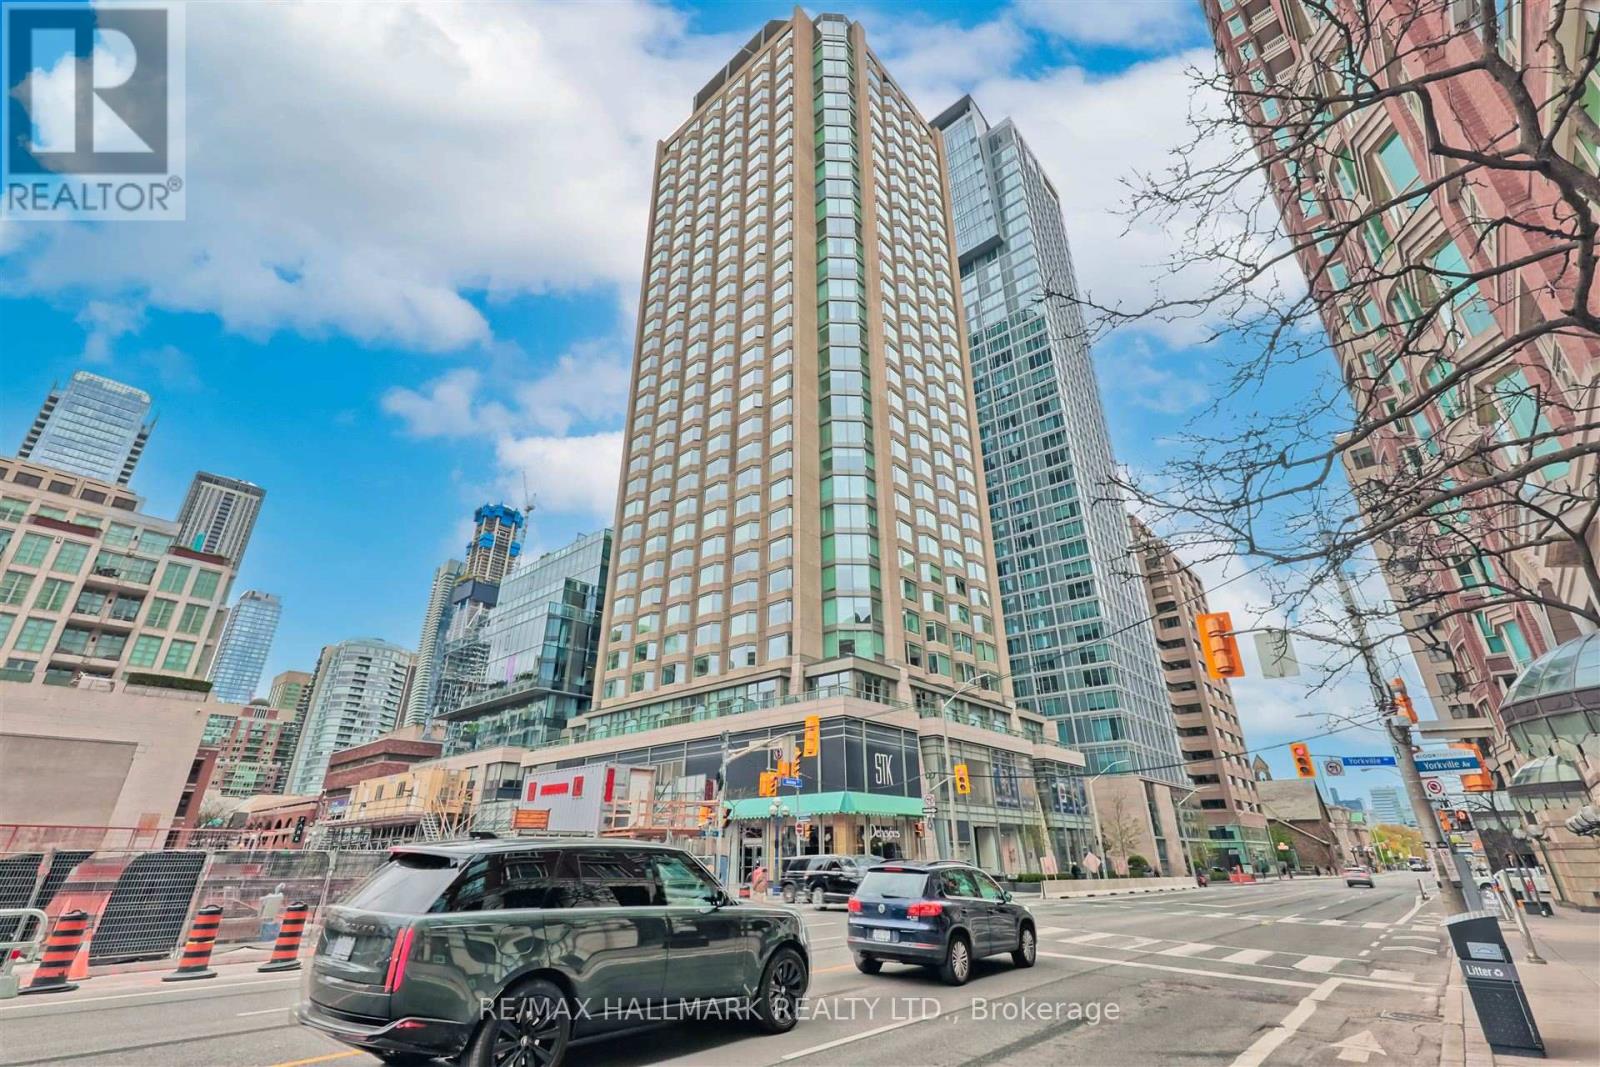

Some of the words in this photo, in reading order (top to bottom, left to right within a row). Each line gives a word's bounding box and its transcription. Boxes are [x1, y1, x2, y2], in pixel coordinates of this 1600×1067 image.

[1348, 757, 1381, 765] Yorkville
[1423, 760, 1460, 770] Yorkville
[874, 752, 894, 785] STK
[1465, 964, 1491, 976] Litter
